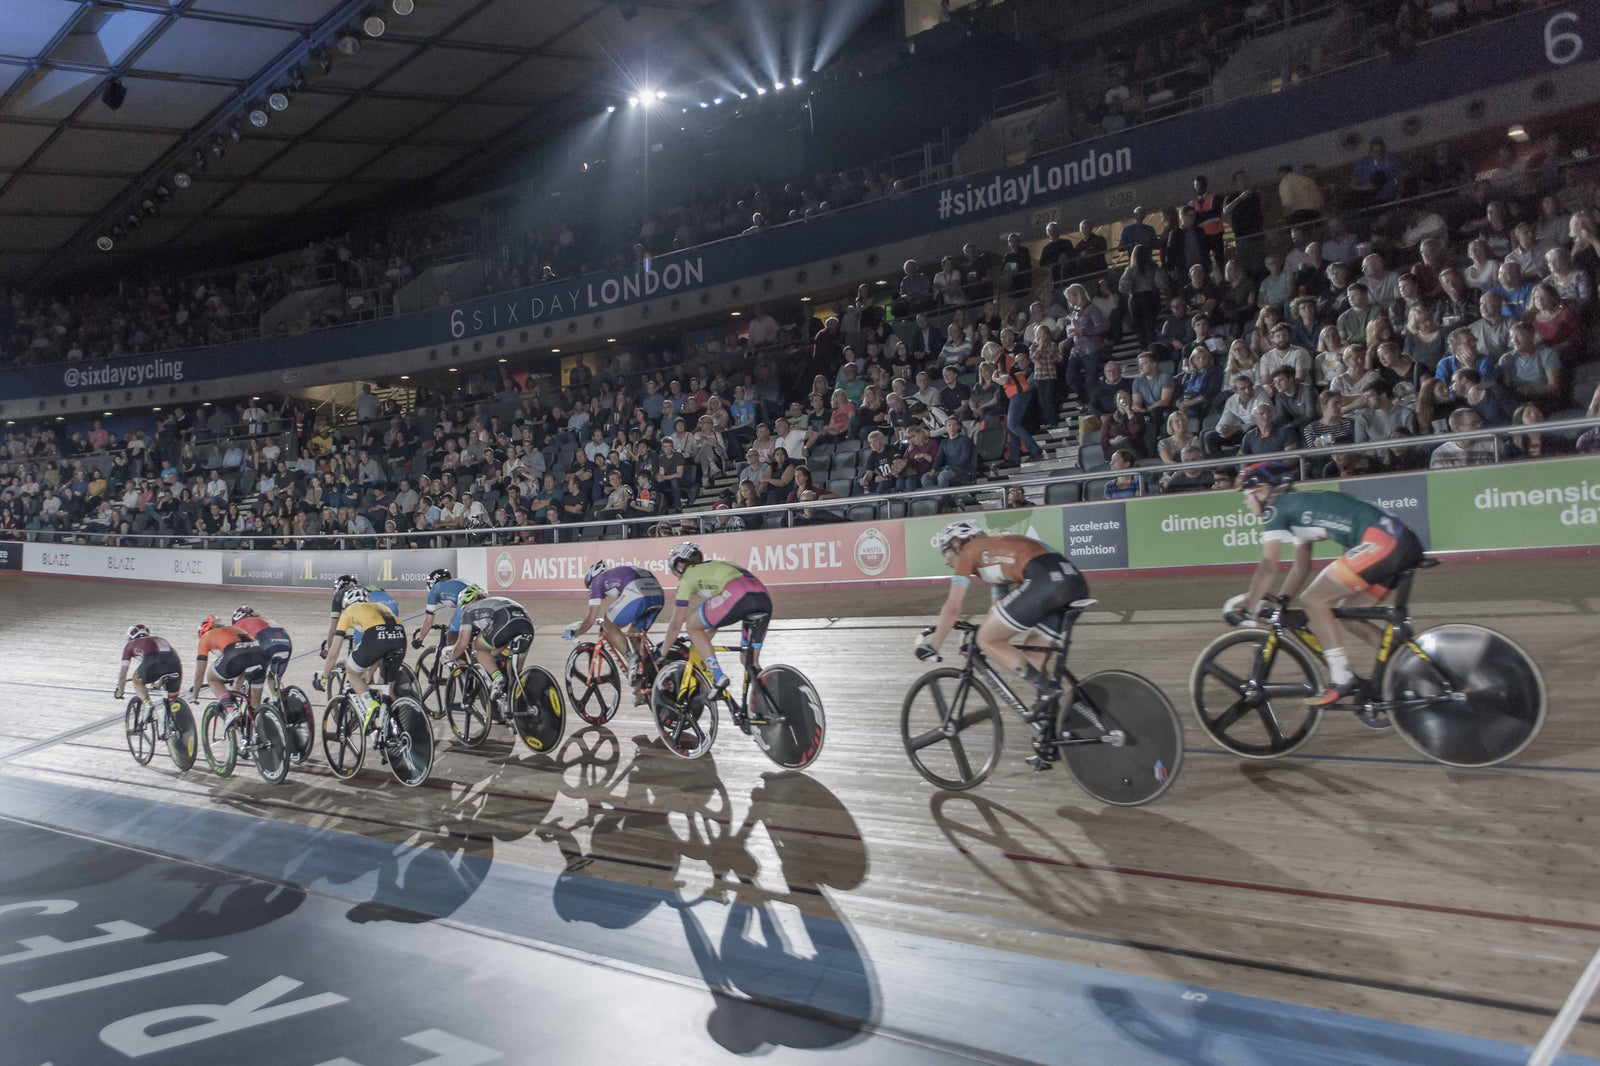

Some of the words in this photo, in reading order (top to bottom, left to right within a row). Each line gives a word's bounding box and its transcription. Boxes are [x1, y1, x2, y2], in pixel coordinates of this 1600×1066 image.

[1544, 12, 1583, 64] 6
[938, 147, 1132, 219] #sixdayLondon
[450, 309, 465, 338] 6
[472, 302, 519, 331] SIX
[531, 290, 581, 319] DAY
[587, 257, 704, 307] LONDON
[64, 358, 183, 387] @sixdaycycling
[1069, 520, 1120, 532] accelerate
[1069, 534, 1093, 545] your
[747, 541, 842, 571] AMSTEL
[1070, 544, 1116, 556] ambition
[42, 552, 70, 566] BLAZE
[107, 556, 135, 571] BLAZE
[174, 559, 202, 574] BLAZE
[521, 556, 587, 579] AMSTEL
[400, 573, 429, 581] ADDISO
